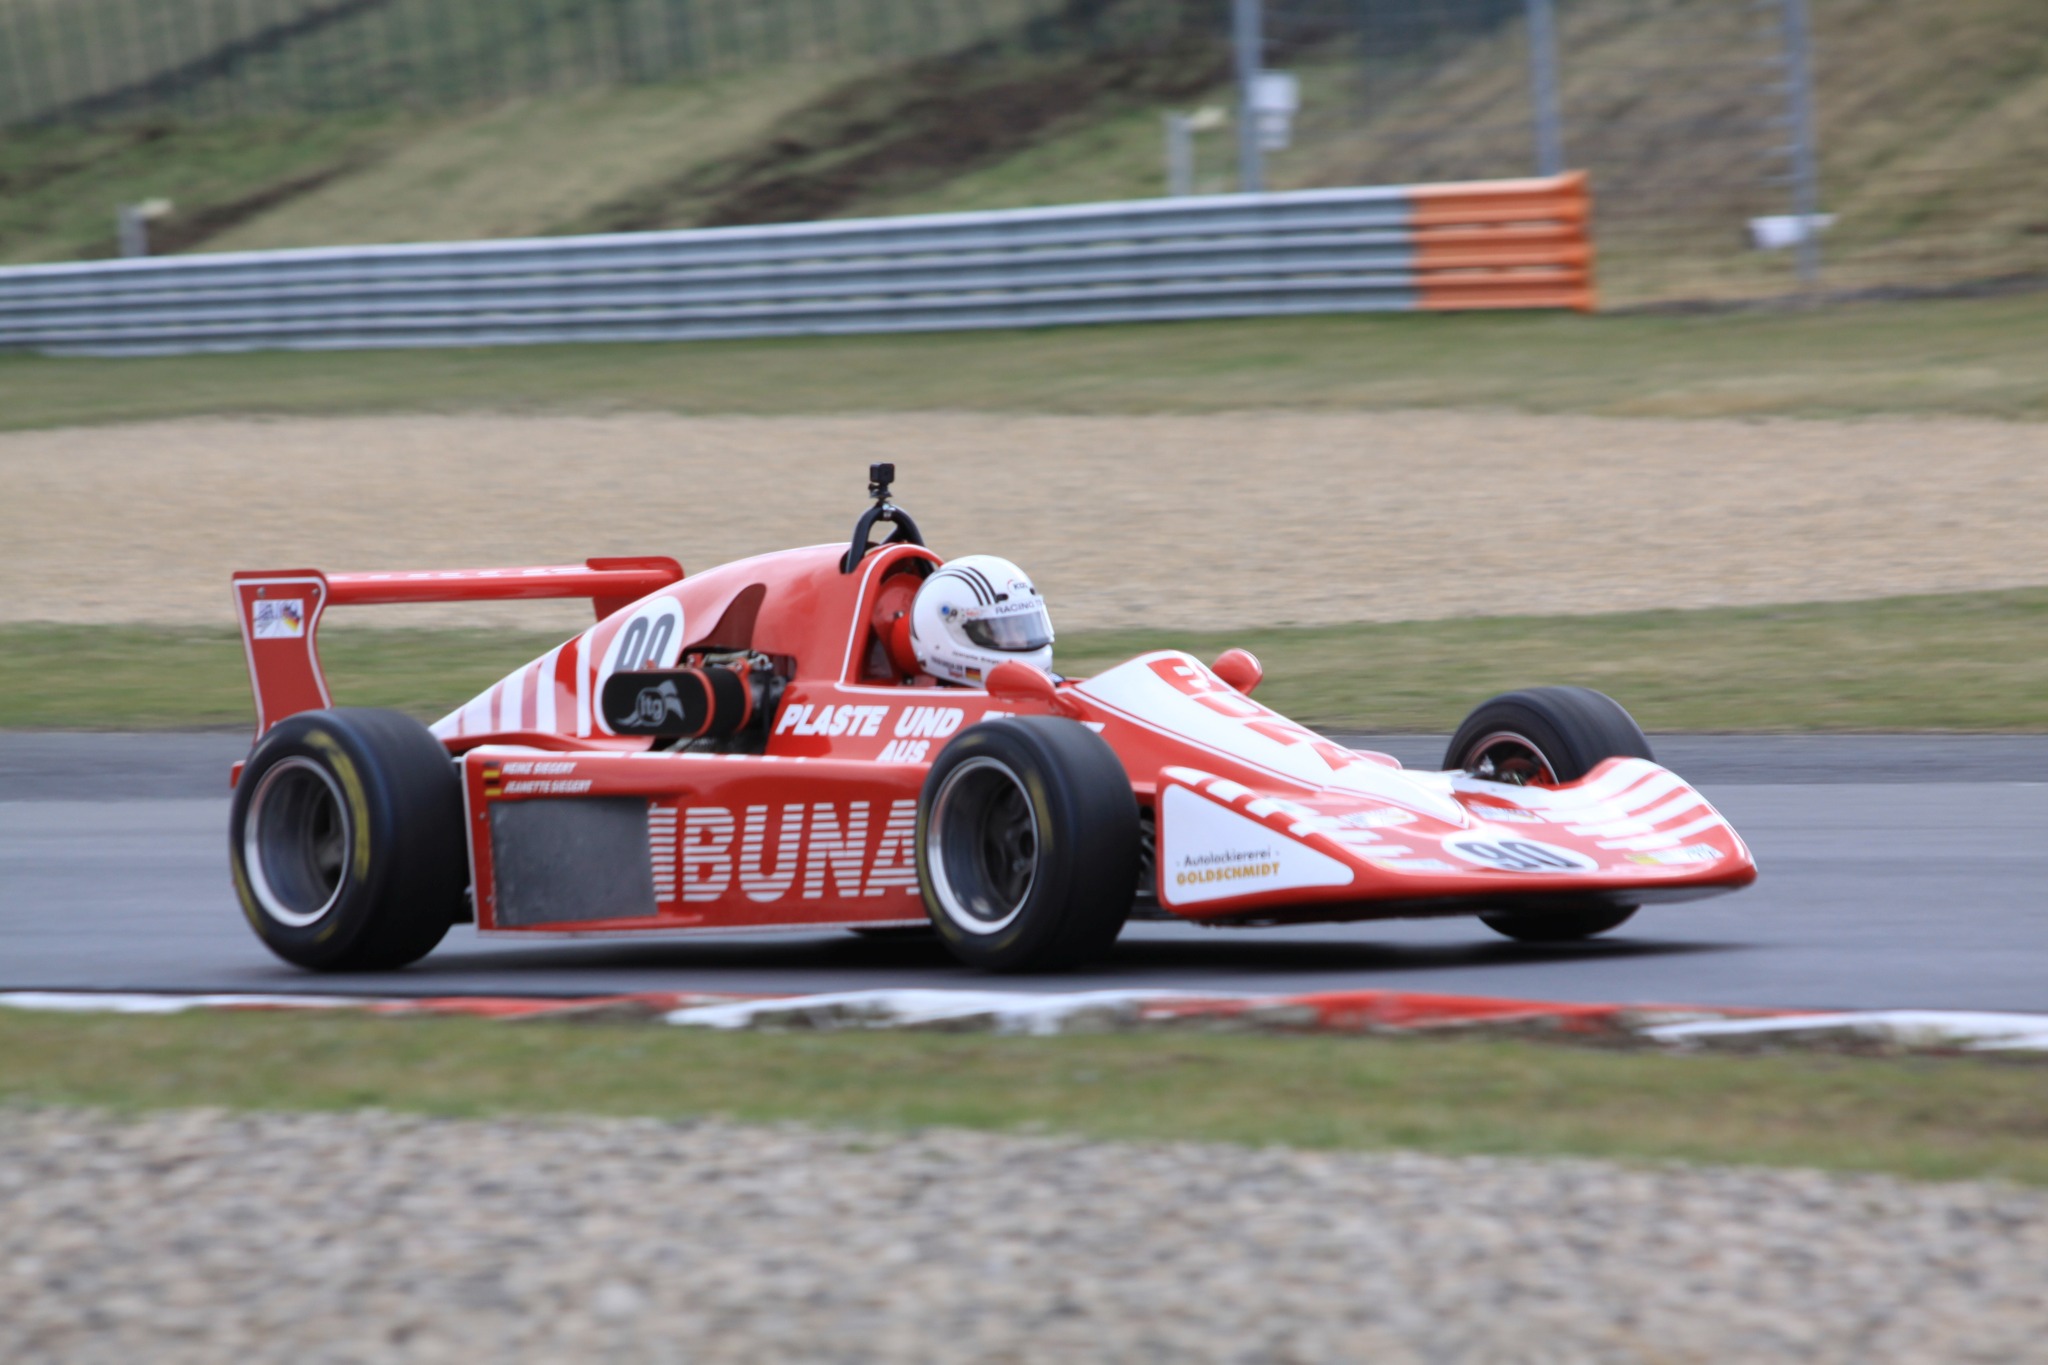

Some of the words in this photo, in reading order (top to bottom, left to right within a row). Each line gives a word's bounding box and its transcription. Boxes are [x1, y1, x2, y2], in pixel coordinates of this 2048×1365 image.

[774, 704, 890, 737] PLASTE
[893, 705, 965, 738] UND
[875, 739, 931, 763] AUS
[1184, 847, 1272, 868] Autolackiererei
[1454, 841, 1586, 872] 90
[1176, 862, 1280, 886] GOLDSCHMIDT
